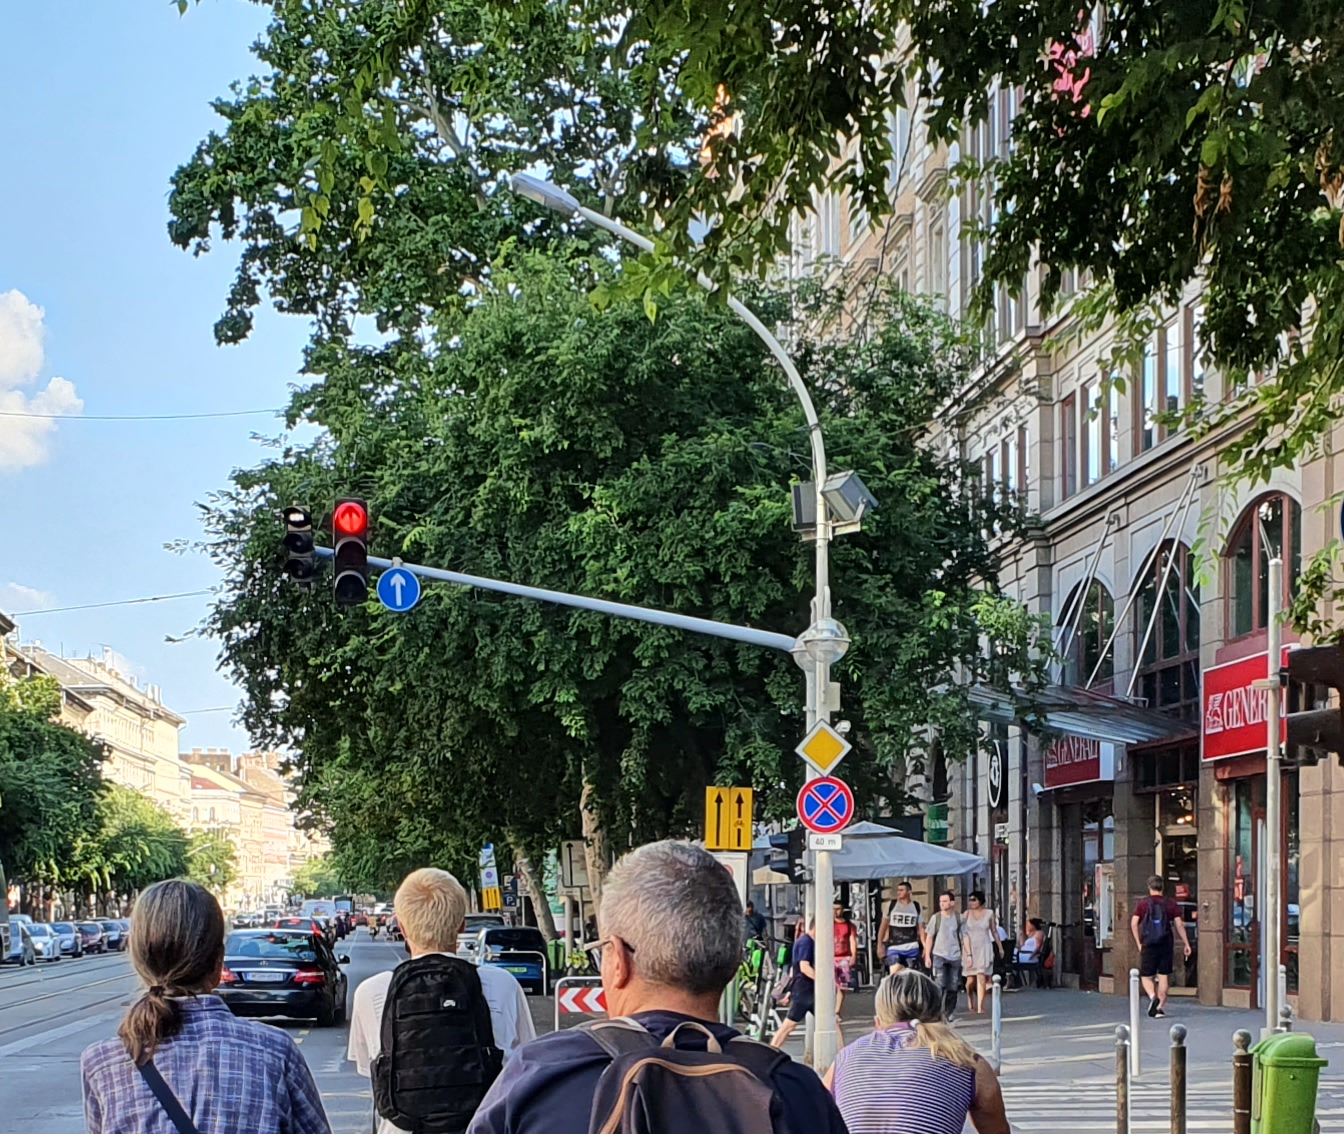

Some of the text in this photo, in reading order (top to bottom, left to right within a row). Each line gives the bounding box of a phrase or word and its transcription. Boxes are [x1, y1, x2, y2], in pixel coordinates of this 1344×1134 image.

[1223, 684, 1287, 730] GENERI
[815, 838, 825, 846] 40
[892, 914, 916, 925] FREE
